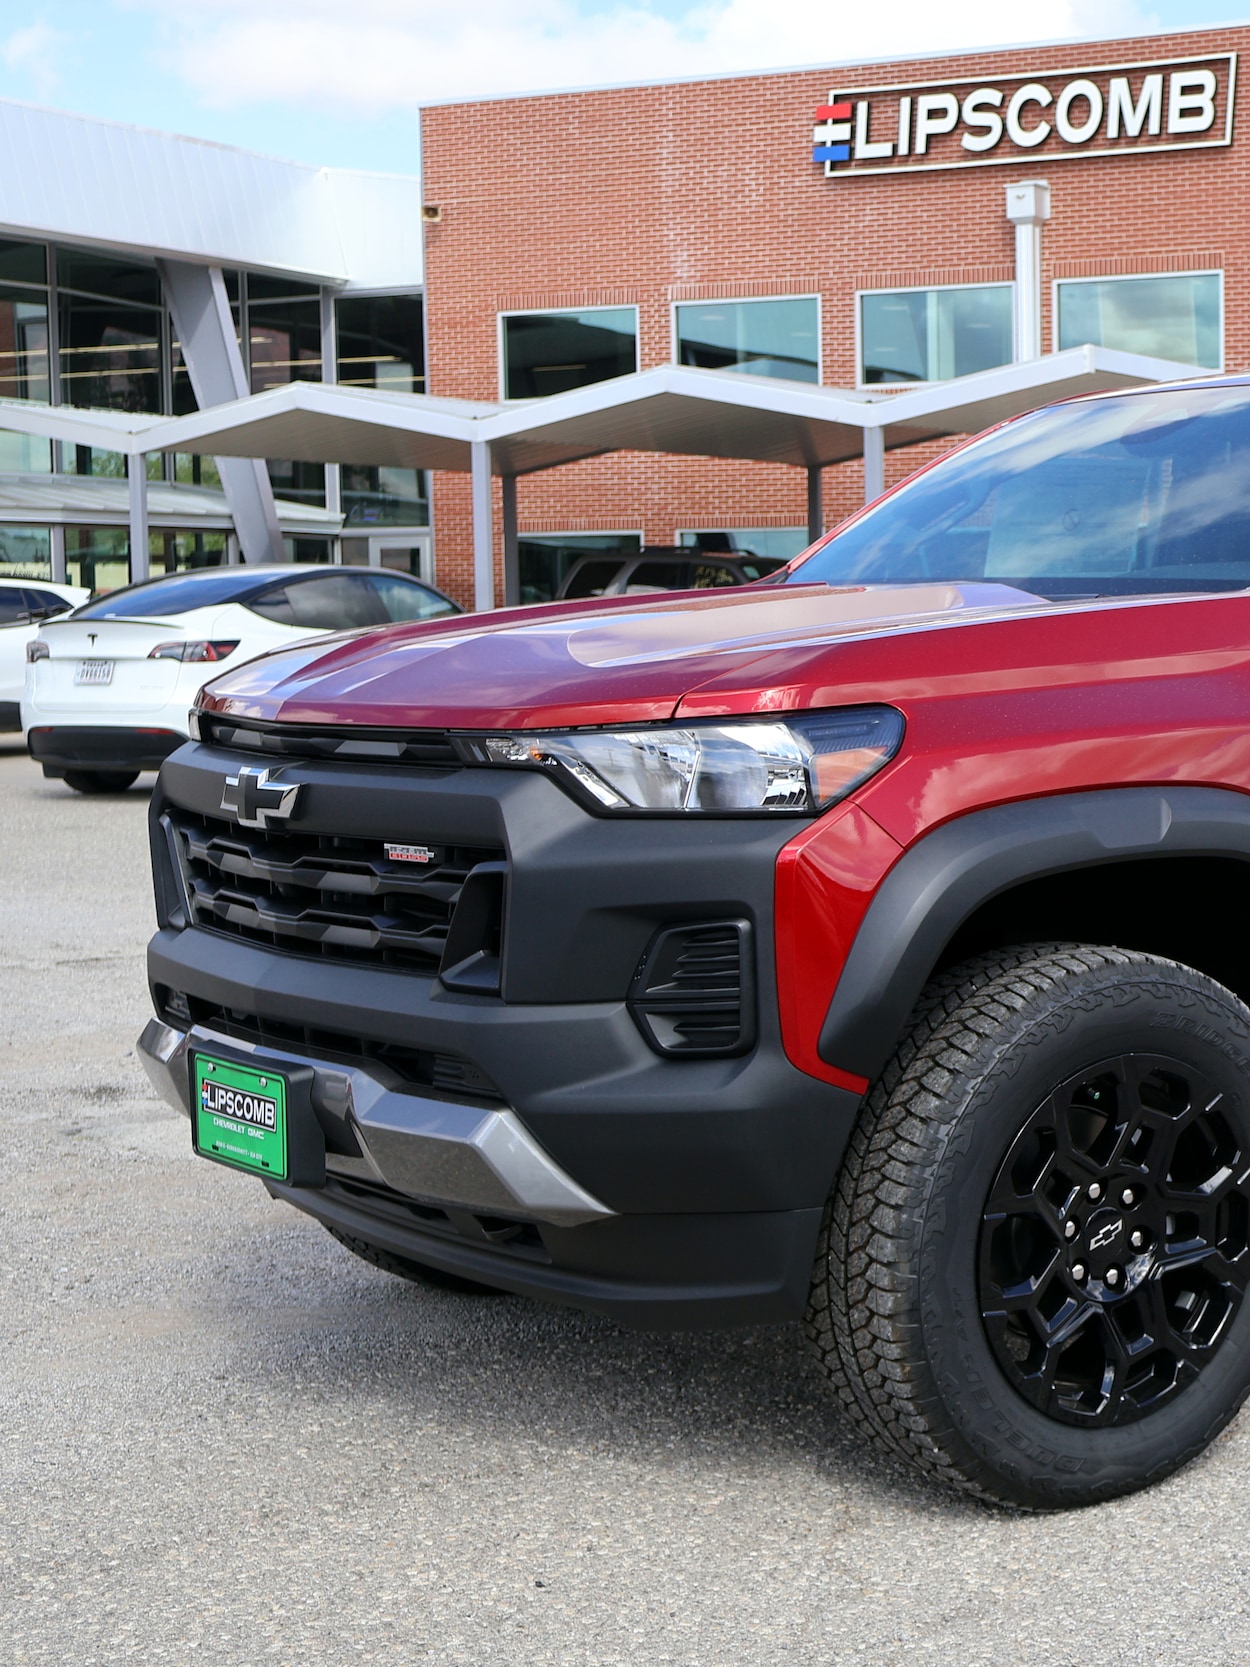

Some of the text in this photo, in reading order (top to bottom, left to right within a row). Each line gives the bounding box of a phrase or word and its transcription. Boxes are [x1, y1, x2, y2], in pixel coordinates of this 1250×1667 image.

[854, 69, 1217, 160] LIPSCOMB
[207, 1085, 275, 1126] LIPSCOMB
[213, 1117, 245, 1134] CHEVROLET
[960, 1353, 1086, 1473] DUELER
